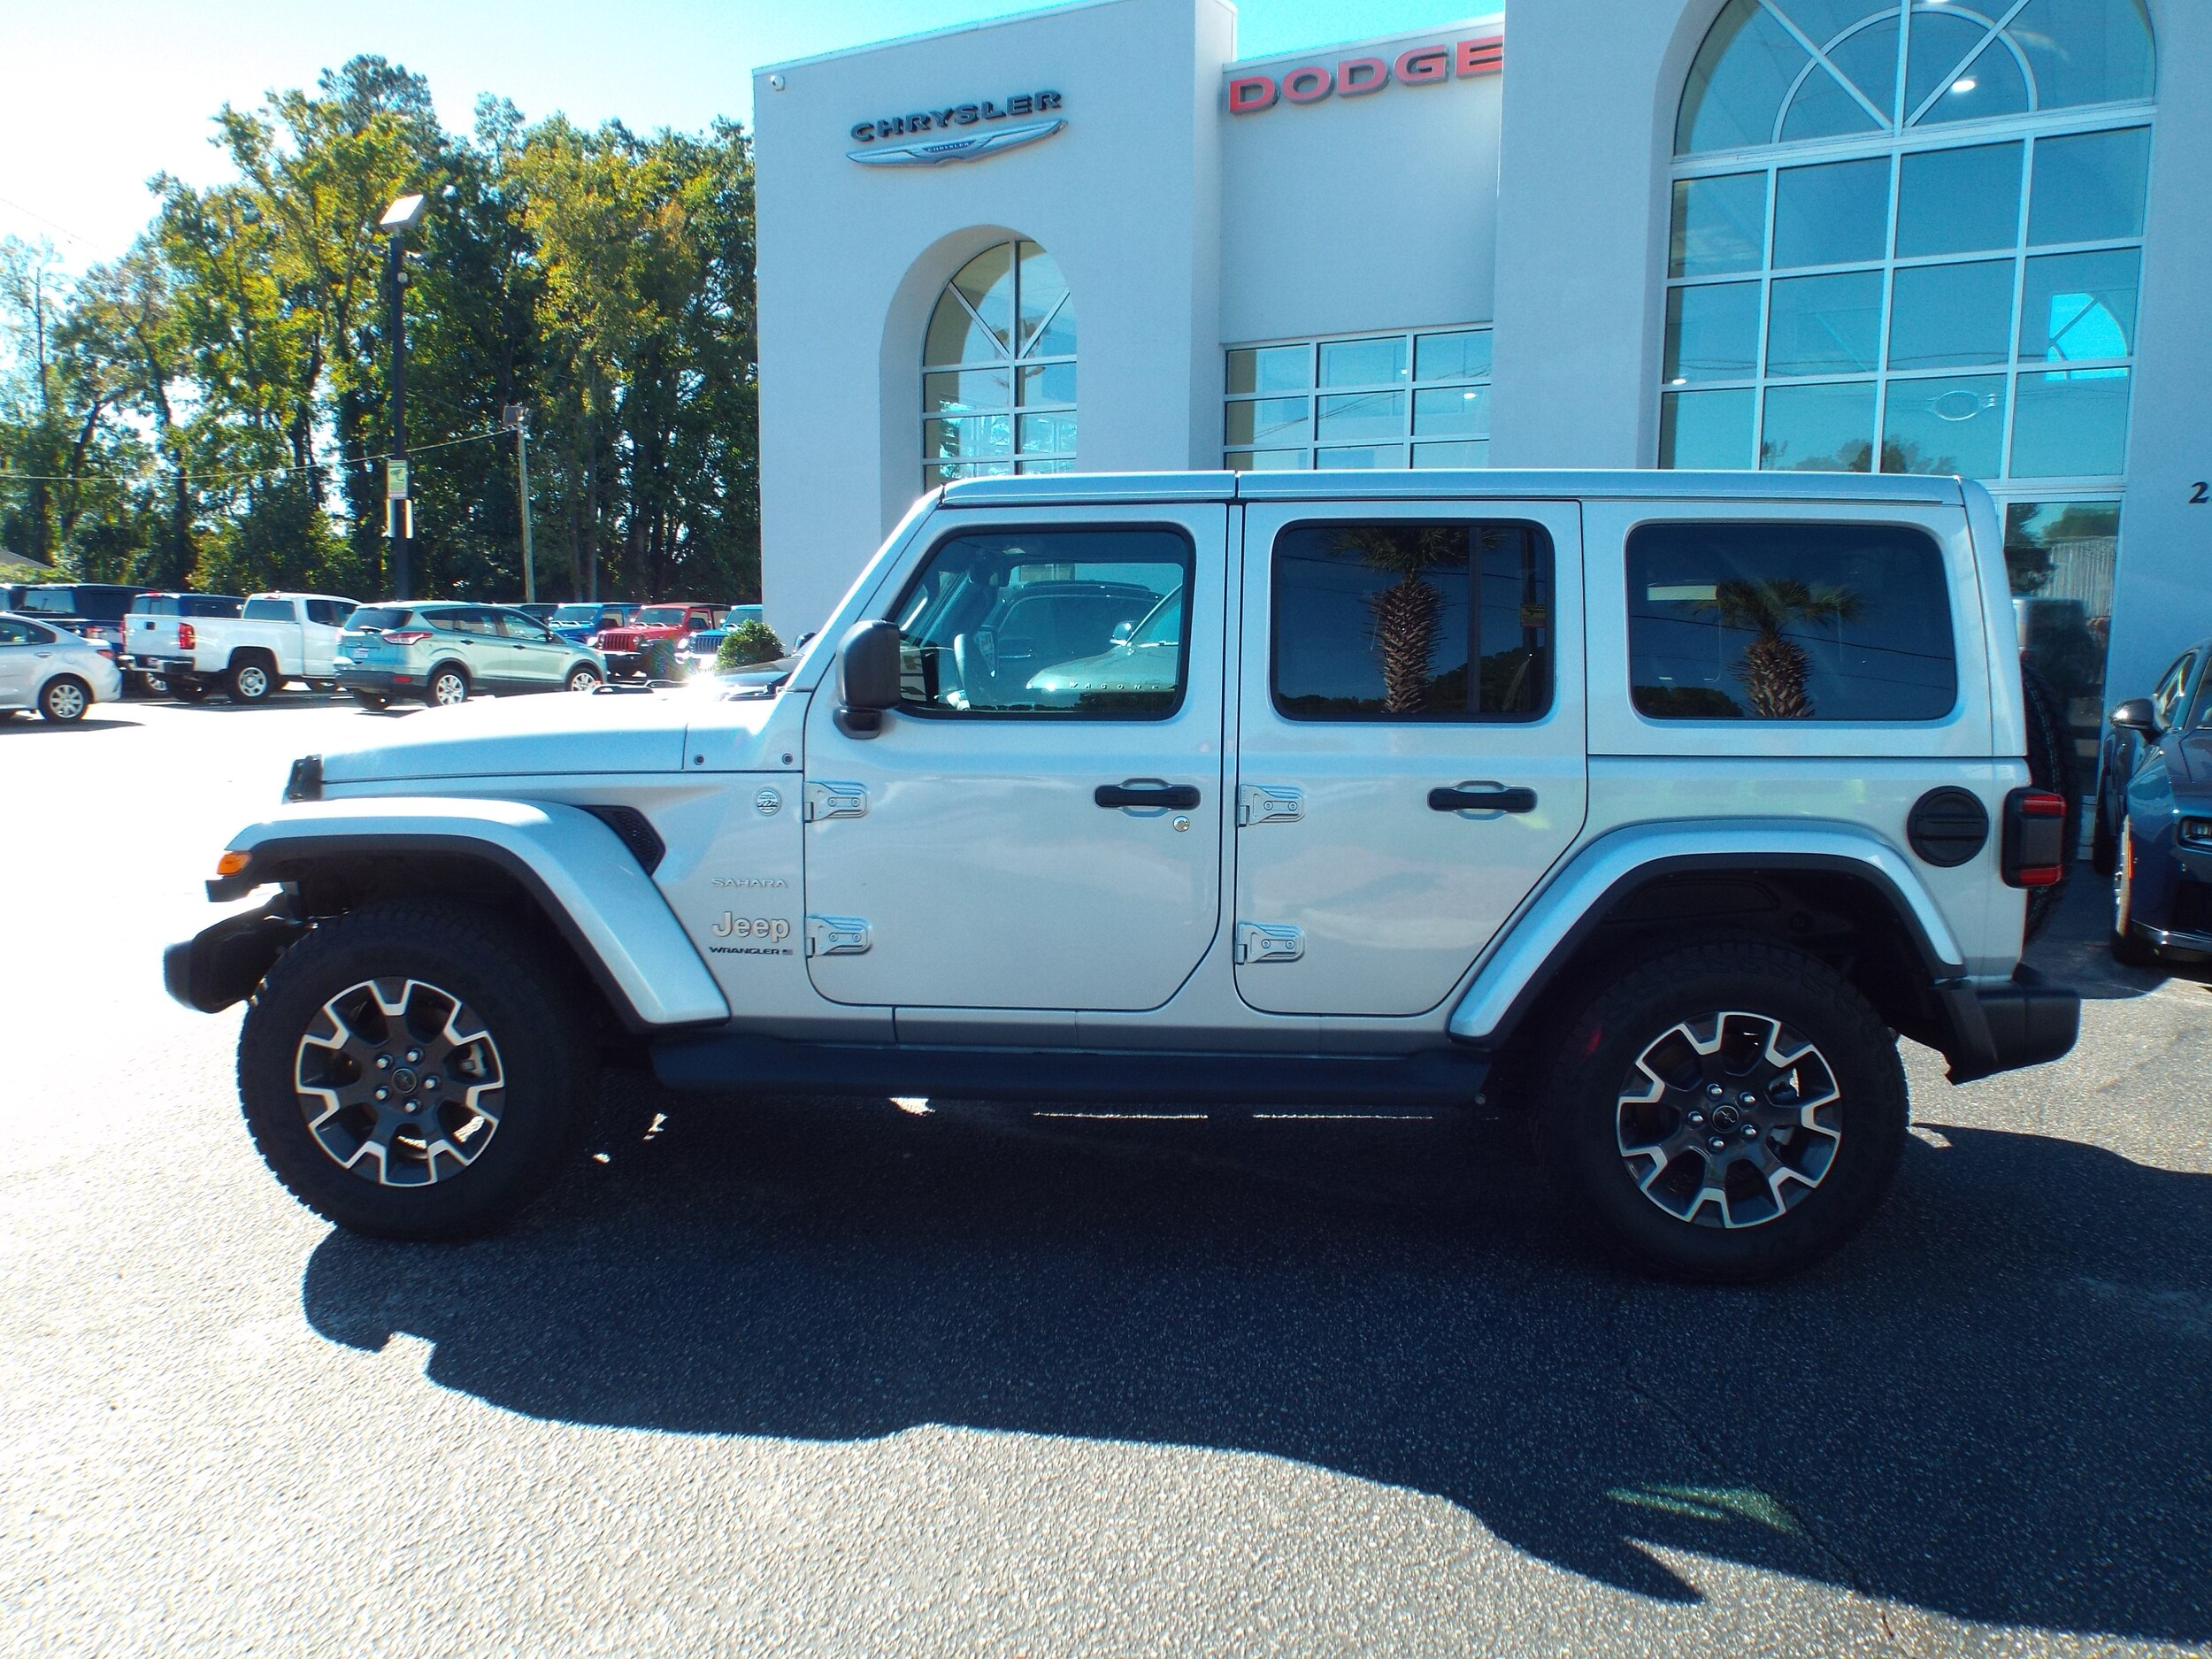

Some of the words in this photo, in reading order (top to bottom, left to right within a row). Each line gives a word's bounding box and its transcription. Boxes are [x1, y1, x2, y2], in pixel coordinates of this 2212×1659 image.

[1229, 35, 1503, 114] DODGE
[850, 89, 1062, 142] CHRYSLER
[711, 878, 788, 888] SAHARA
[711, 910, 790, 943] Jeep
[710, 947, 780, 956] WRANGLER
